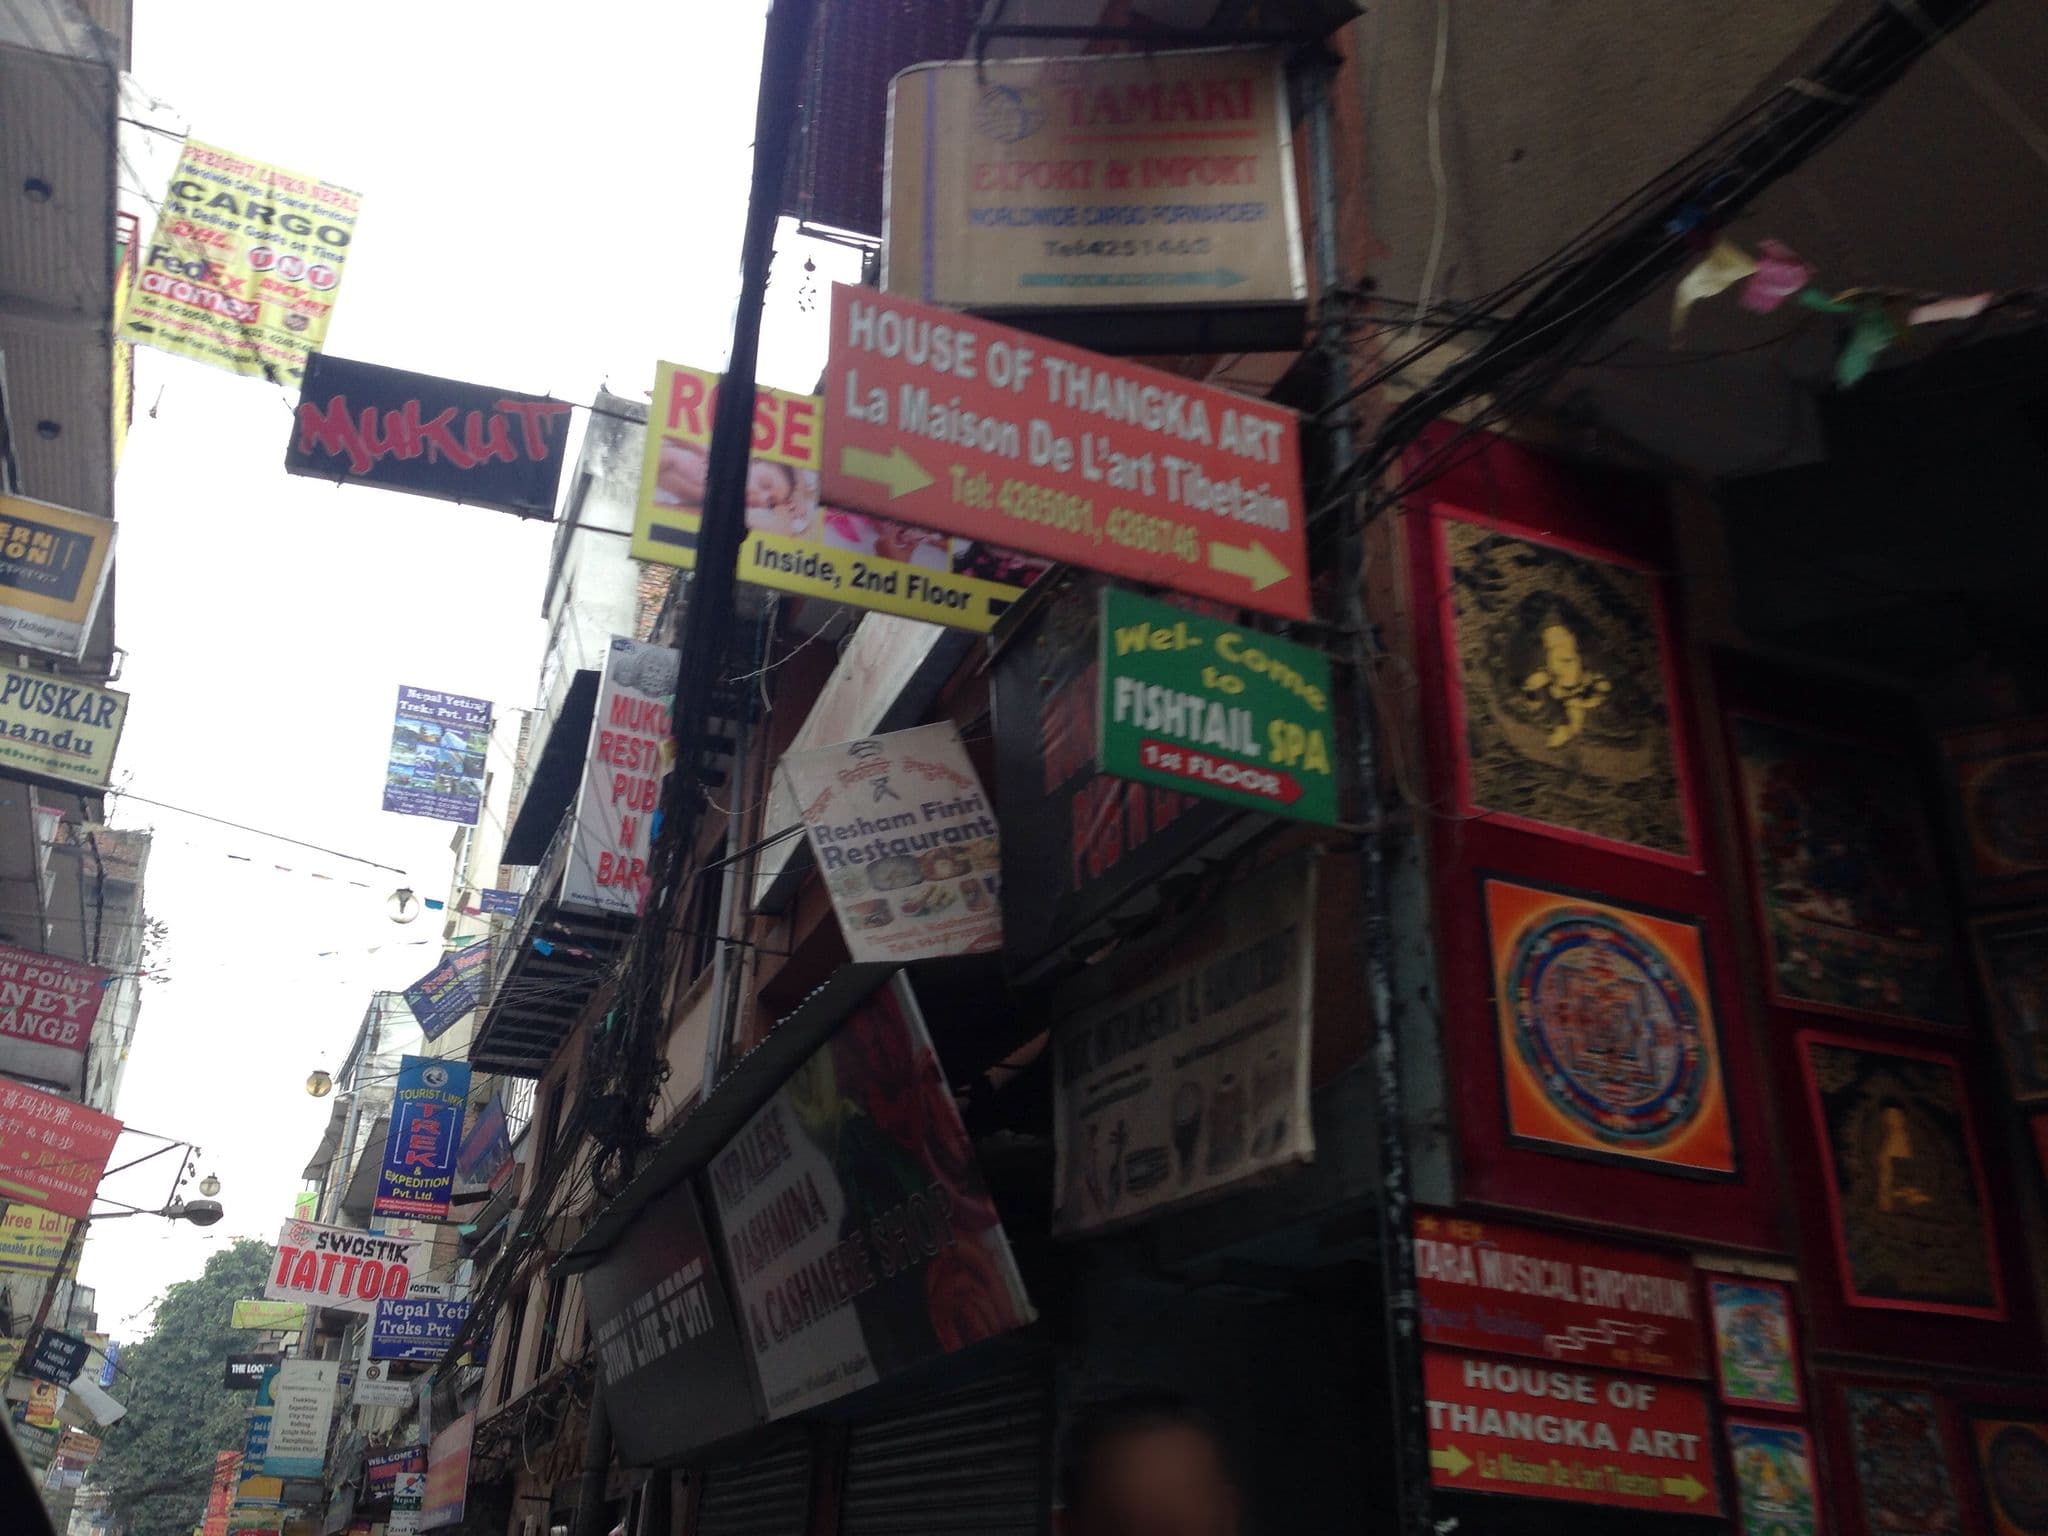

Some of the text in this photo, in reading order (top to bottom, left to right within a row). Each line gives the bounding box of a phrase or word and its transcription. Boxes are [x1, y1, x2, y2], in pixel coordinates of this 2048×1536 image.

[971, 158, 1091, 192] EXPORT
[1141, 155, 1257, 187] IMPORT
[170, 180, 351, 248] CARGO
[147, 245, 246, 295] FedEx
[848, 300, 1285, 465] HOUSE OF THANGKA ART
[845, 369, 889, 426] La
[900, 383, 1021, 459] Maison
[1028, 418, 1074, 473] De
[1081, 431, 1156, 497] L'art
[754, 540, 972, 611] Inside, 2nd Floor
[1202, 665, 1246, 695] to
[1113, 675, 1332, 776] FISHTAIL SPA
[610, 772, 658, 814] PUB
[1186, 752, 1281, 796] FLOOR
[813, 810, 918, 845] Resham
[822, 814, 996, 870] Restaurant
[596, 850, 646, 893] BAR
[23, 967, 94, 993] POINT
[399, 1088, 442, 1102] TOURIST
[404, 1103, 444, 1169] TREK
[384, 1169, 451, 1188] EXPEDITION
[413, 1166, 422, 1176] &
[392, 1188, 434, 1202] Pvt. Ltd.
[39, 1212, 61, 1234] Lal
[730, 1170, 830, 1284] PASHMINA
[316, 1231, 411, 1264] SWOSTIK
[275, 1245, 412, 1302] TATTOO
[764, 1228, 878, 1345] CASHMERE
[1479, 1248, 1580, 1304] MUSICAL
[1580, 1264, 1695, 1321] EMPORIUM
[379, 1319, 456, 1338] Treks Pvt.
[381, 1300, 430, 1321] Nepal
[231, 1363, 247, 1374] THE
[1463, 1360, 1657, 1412] HOUSE OF
[1425, 1400, 1702, 1461] THANGKA ART
